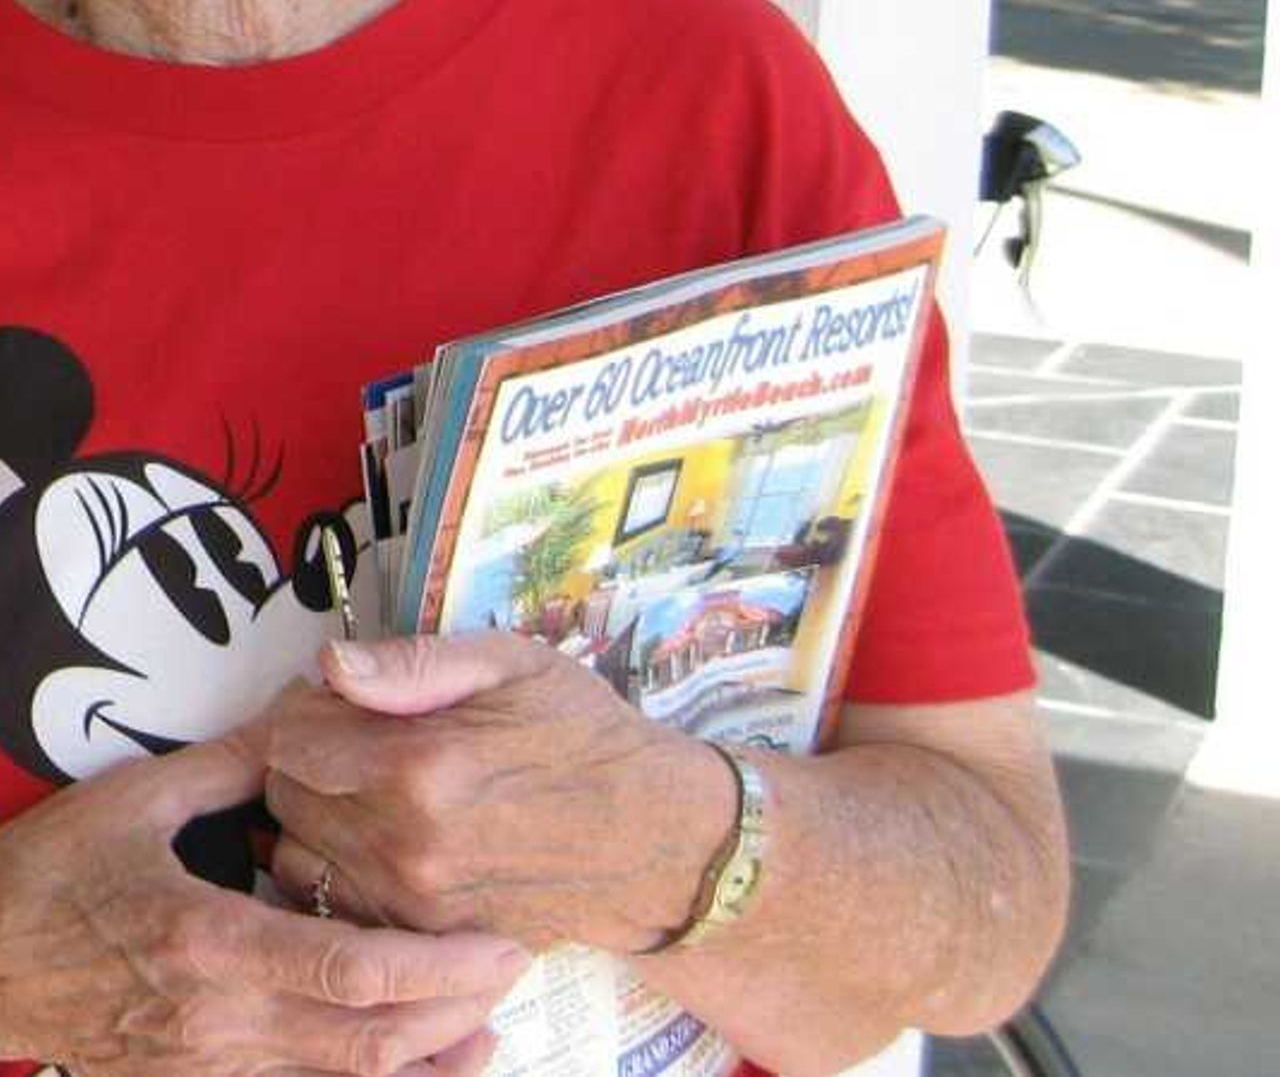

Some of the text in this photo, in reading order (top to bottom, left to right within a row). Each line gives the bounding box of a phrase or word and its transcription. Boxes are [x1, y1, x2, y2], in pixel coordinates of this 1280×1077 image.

[500, 384, 586, 445] Over
[584, 356, 632, 421] 60
[630, 313, 803, 404] Oceanfront
